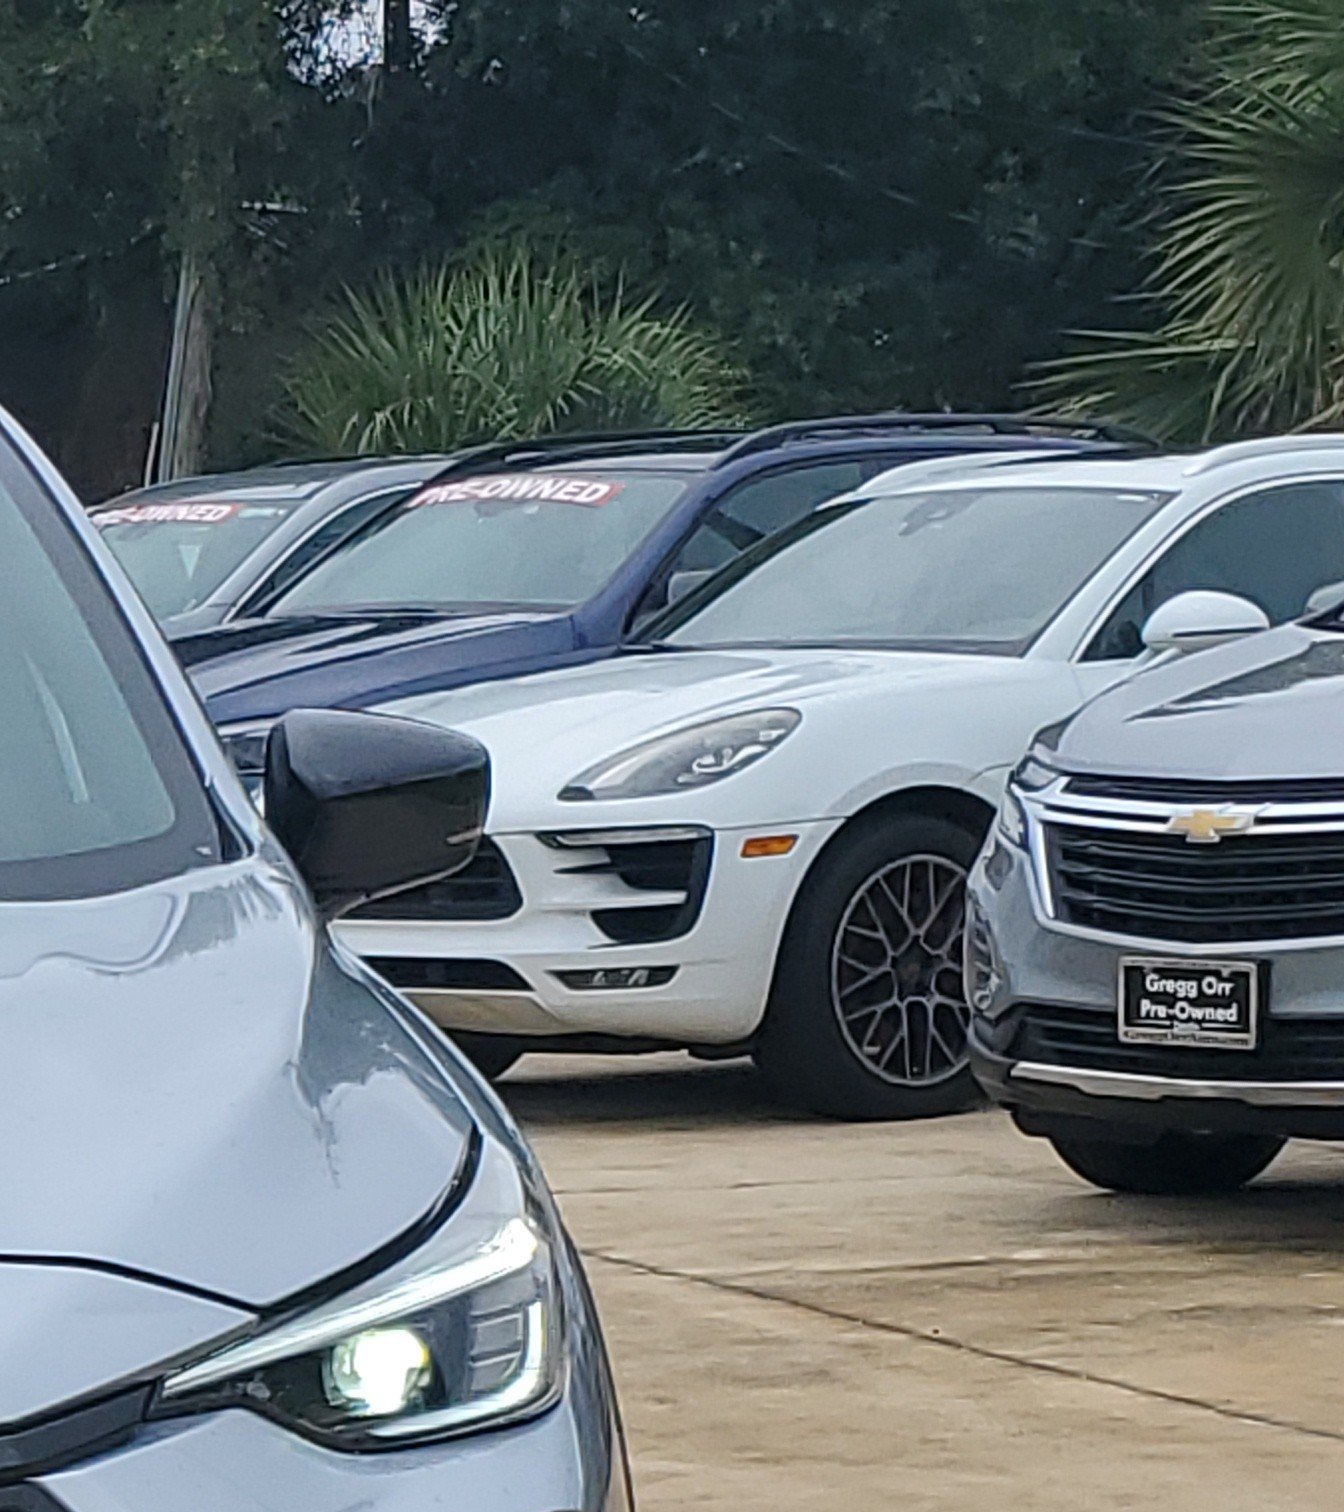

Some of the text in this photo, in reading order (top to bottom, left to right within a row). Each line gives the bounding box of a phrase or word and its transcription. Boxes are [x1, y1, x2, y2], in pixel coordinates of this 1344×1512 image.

[405, 478, 611, 508] PRE-OWNED
[92, 503, 232, 528] E-OWNED
[1145, 973, 1235, 998] Gregg Orr
[1140, 999, 1238, 1022] Pre-Owned
